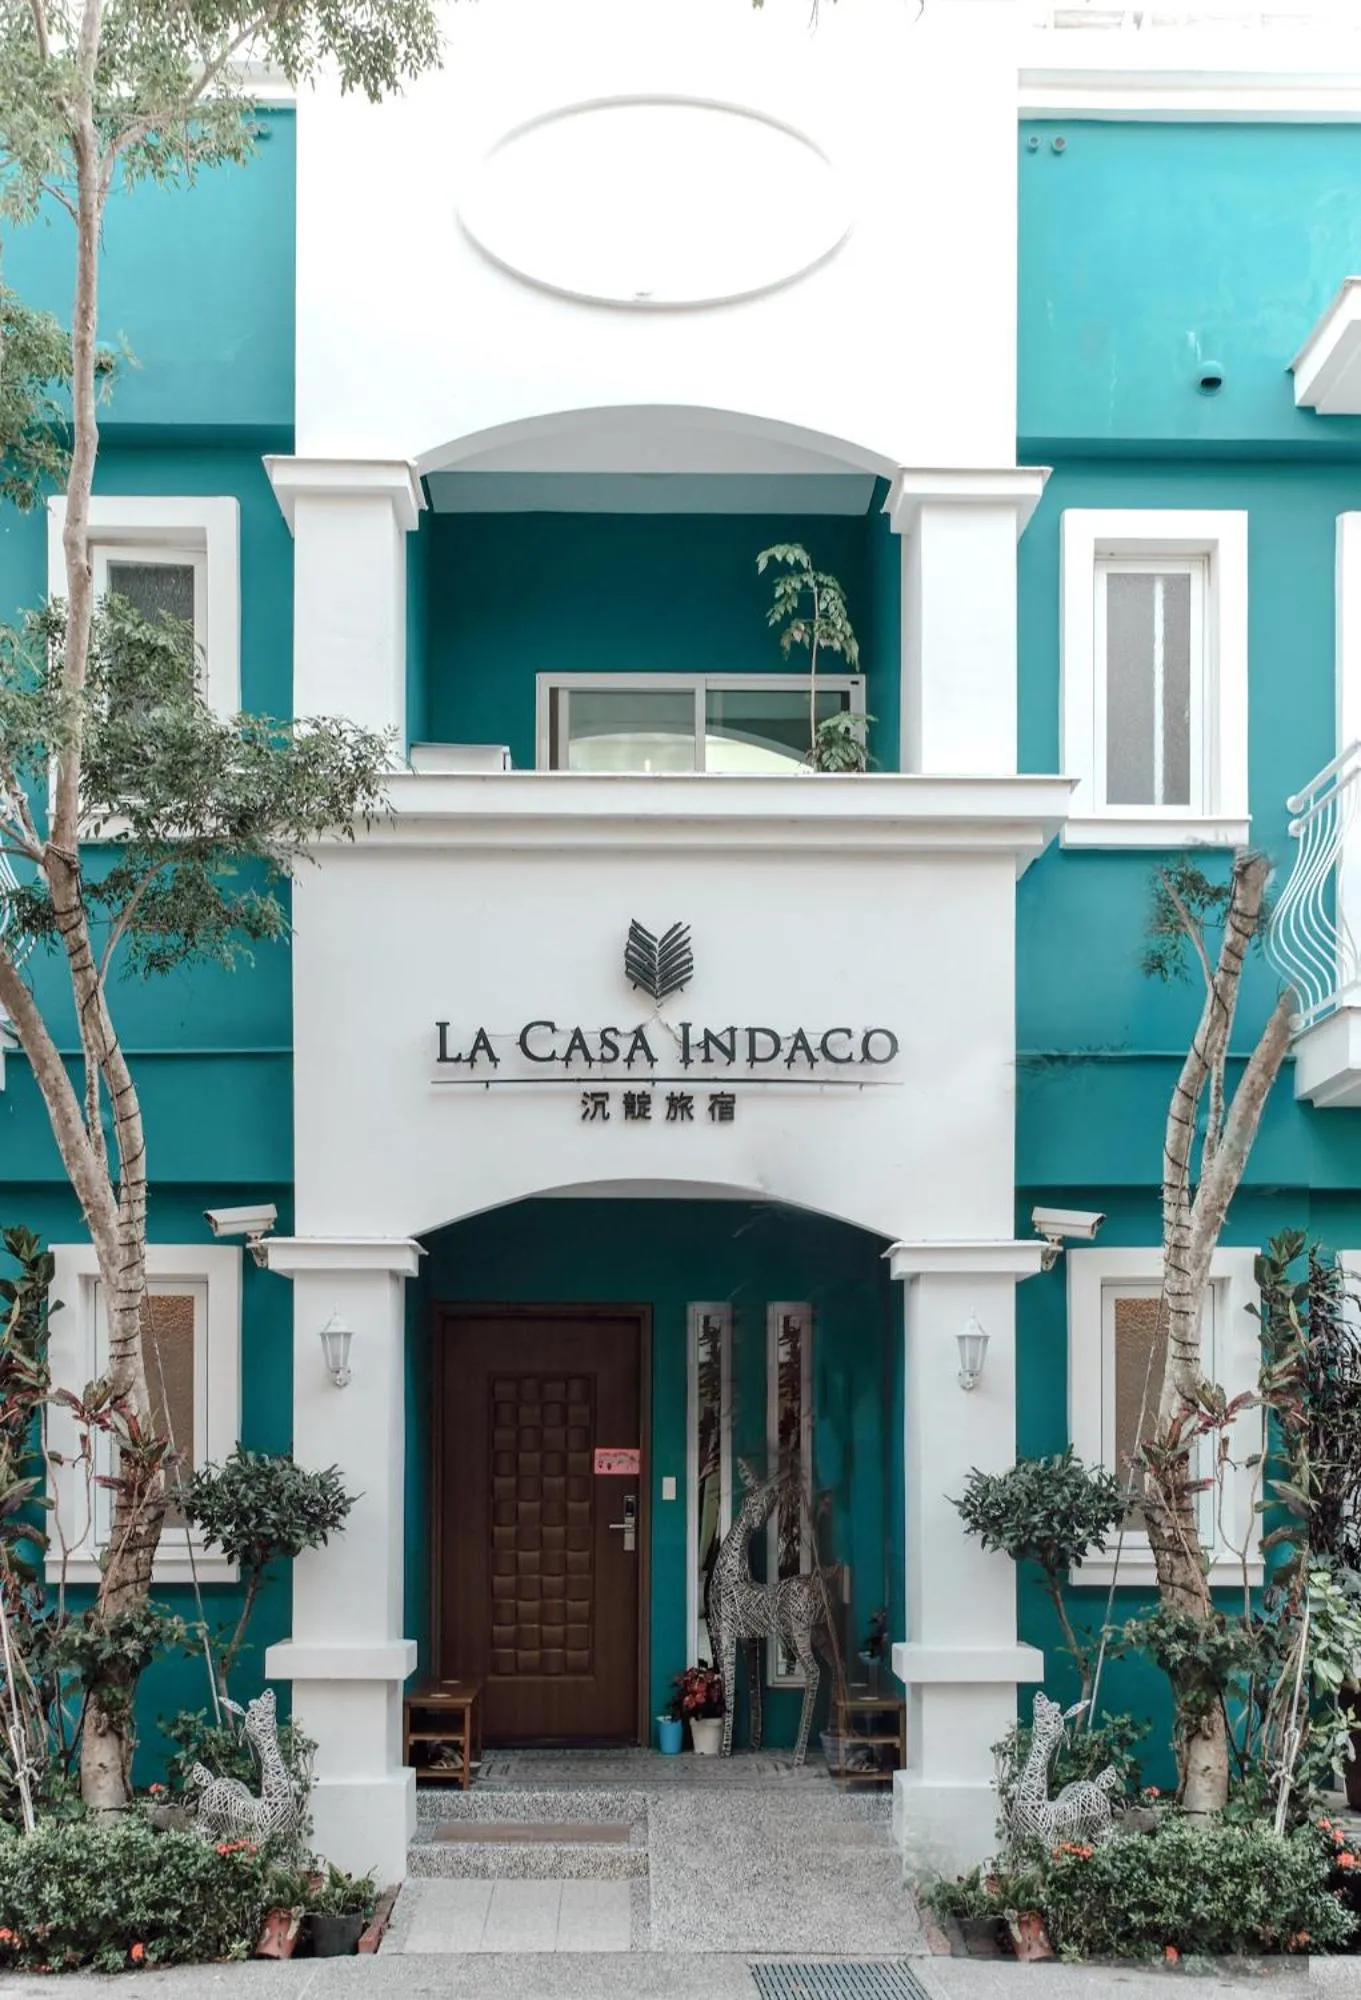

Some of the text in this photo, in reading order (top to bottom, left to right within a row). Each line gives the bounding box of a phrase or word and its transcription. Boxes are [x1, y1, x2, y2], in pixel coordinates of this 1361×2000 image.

[435, 1021, 900, 1064] LA CASA INDACO
